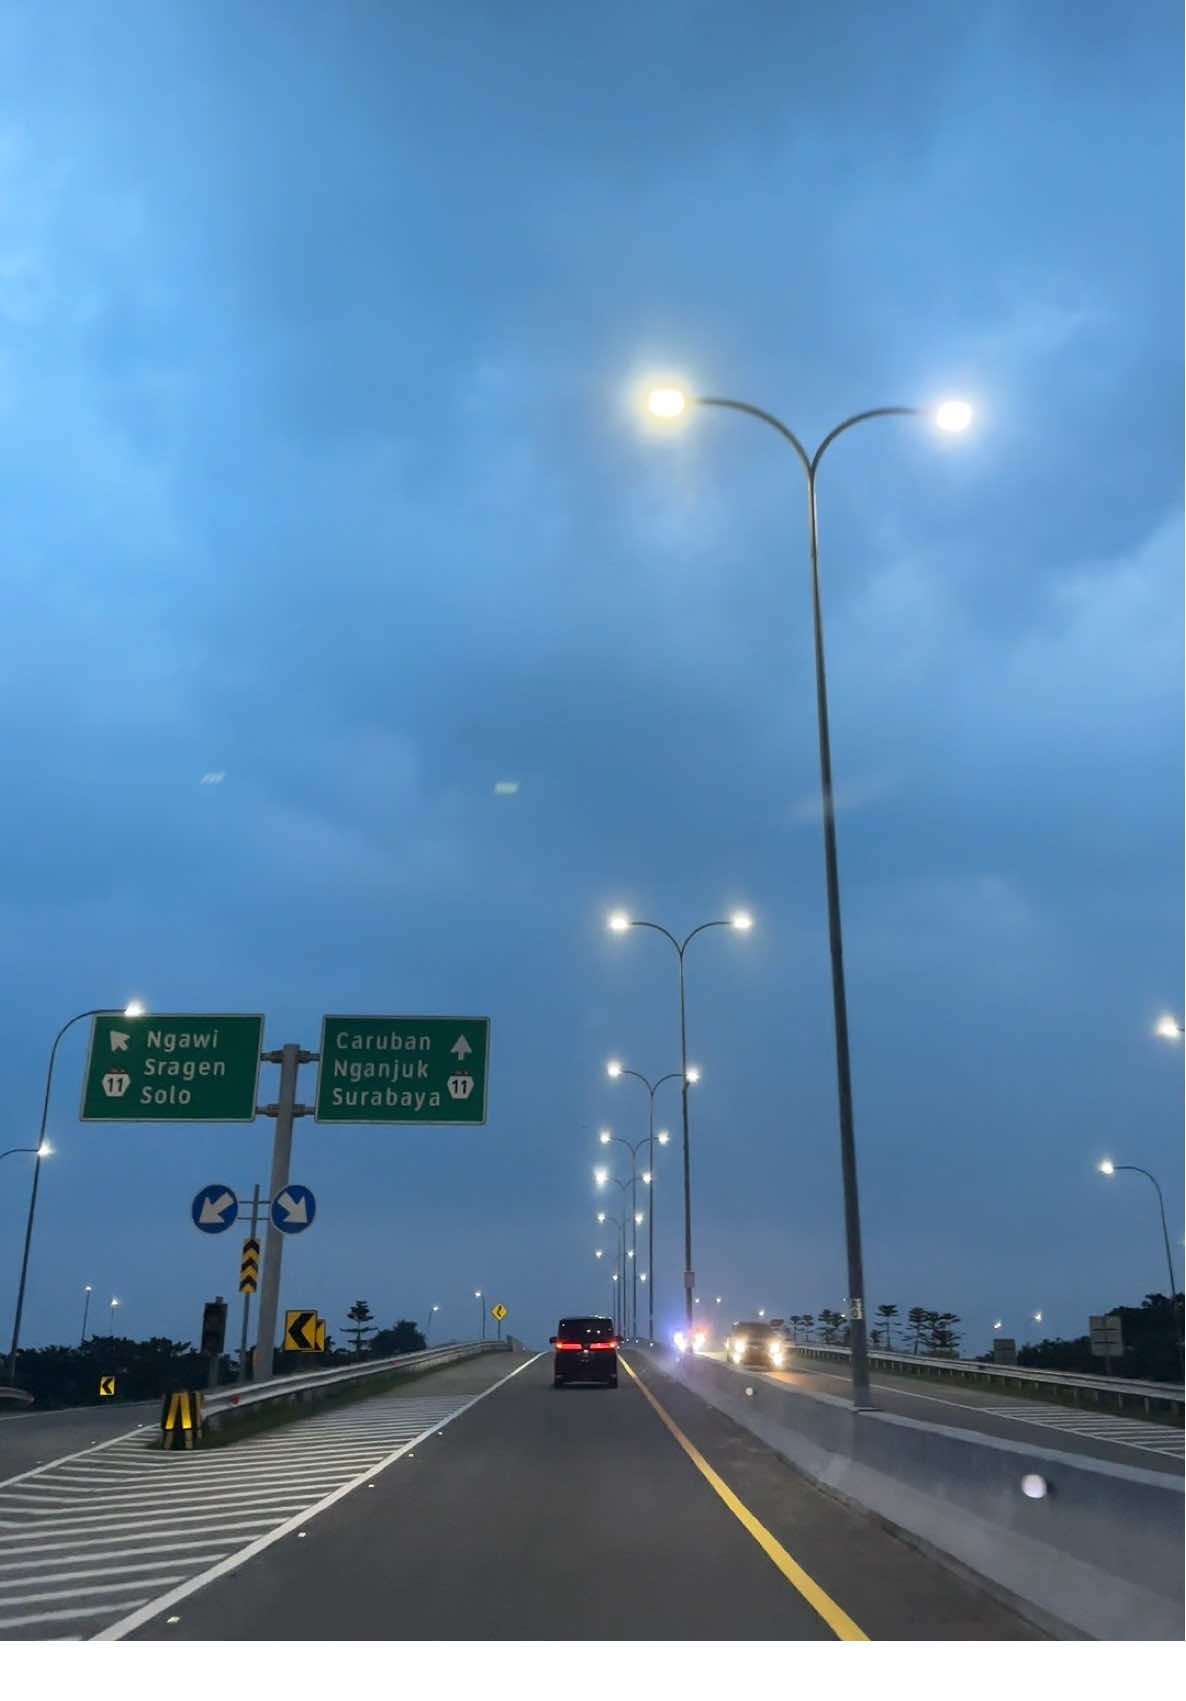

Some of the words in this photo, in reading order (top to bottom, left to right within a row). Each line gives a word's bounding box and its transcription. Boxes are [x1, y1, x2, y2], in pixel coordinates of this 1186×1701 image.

[147, 1029, 219, 1053] Ngawi
[336, 1032, 431, 1051] Caruban
[143, 1058, 226, 1081] Sragen
[334, 1059, 429, 1083] Nganjuk
[107, 1078, 124, 1092] 11
[140, 1085, 192, 1105] Solo
[452, 1080, 468, 1094] 11
[332, 1087, 441, 1112] Surabaya
